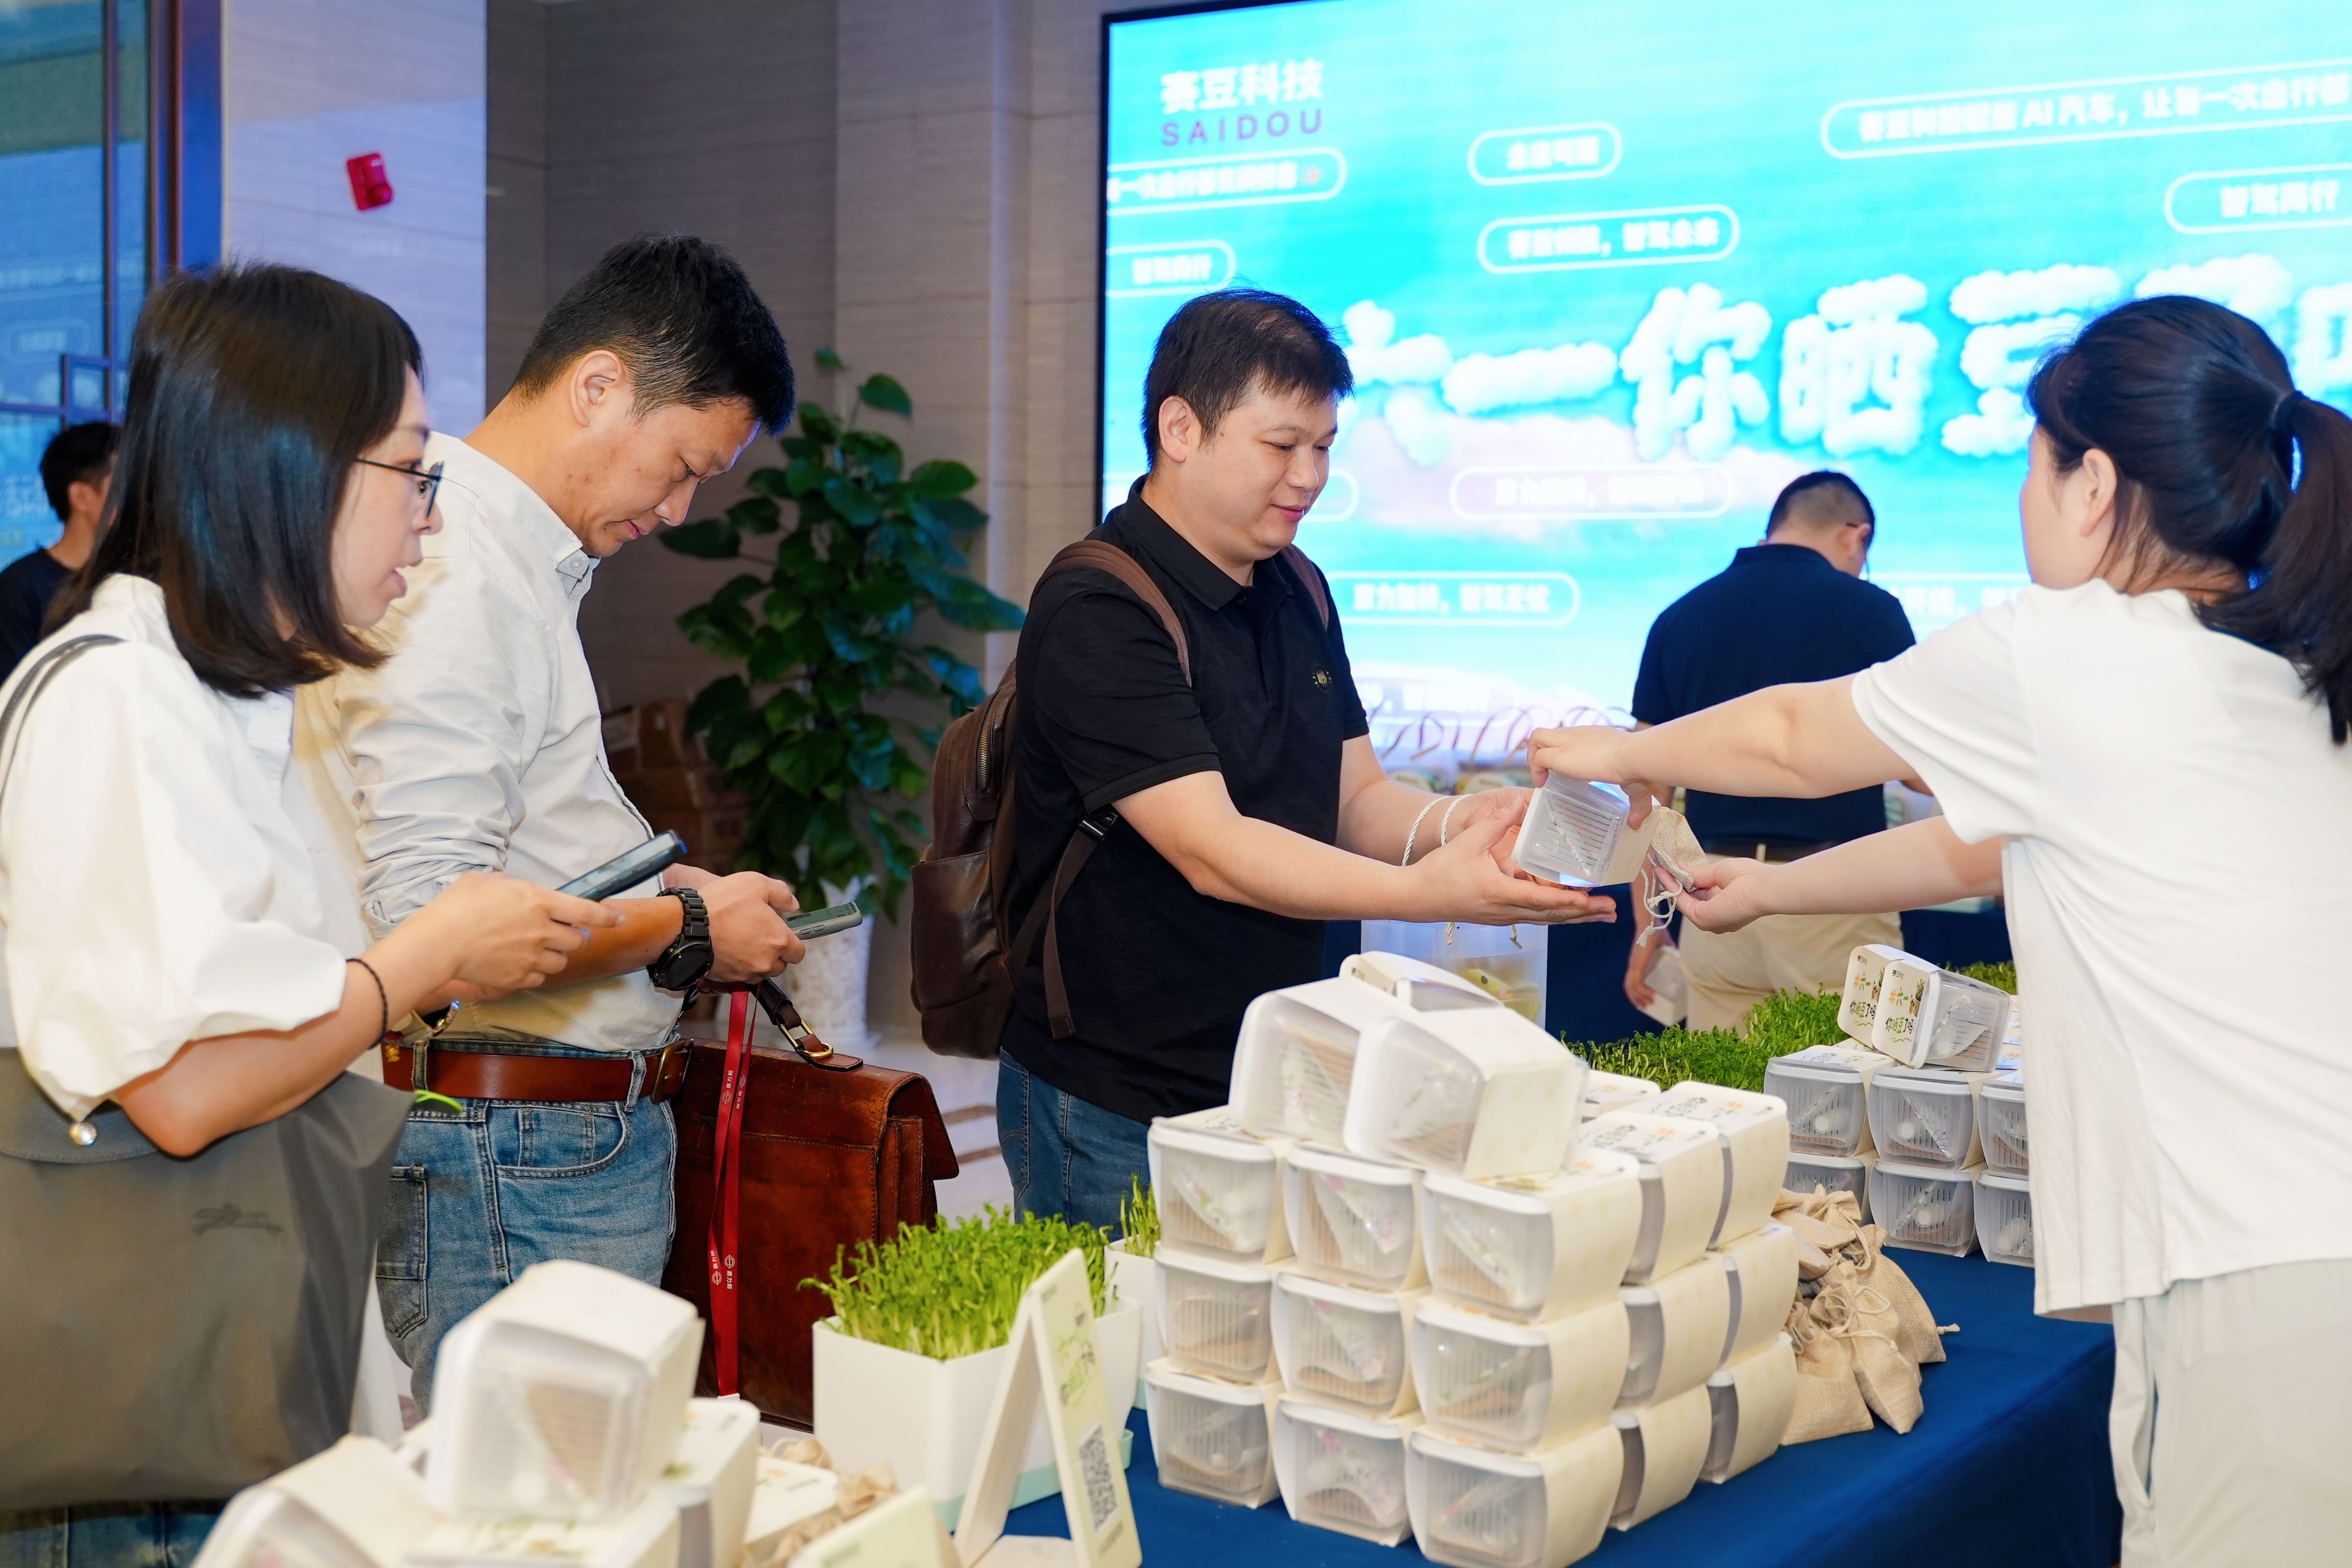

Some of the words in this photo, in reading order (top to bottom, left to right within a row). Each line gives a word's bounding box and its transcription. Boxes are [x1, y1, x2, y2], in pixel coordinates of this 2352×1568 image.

[1160, 57, 1324, 115] 赛豆科技
[1162, 109, 1322, 147] SAIDOU
